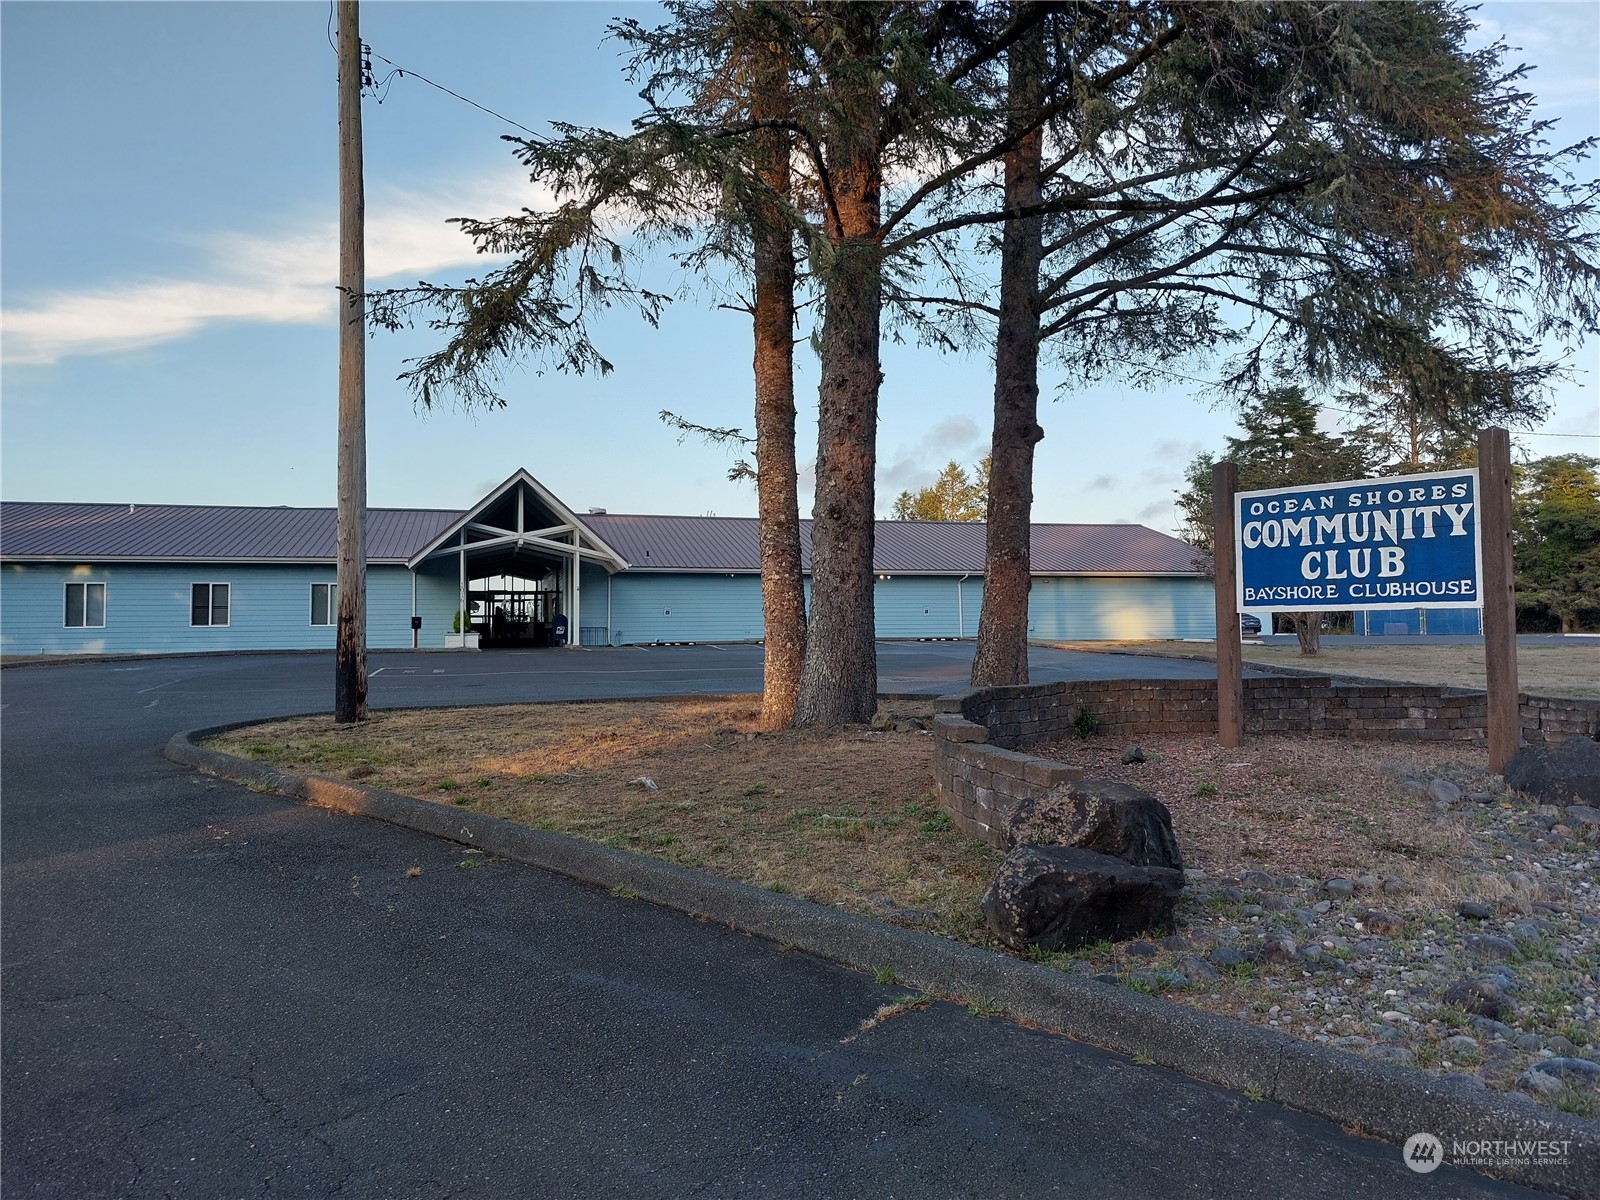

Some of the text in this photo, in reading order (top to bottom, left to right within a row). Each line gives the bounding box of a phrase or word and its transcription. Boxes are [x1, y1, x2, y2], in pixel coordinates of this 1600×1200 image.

[1250, 483, 1468, 516] OCEAN SHORES
[1242, 502, 1474, 549] COMMUNITY
[1300, 546, 1406, 580] CLUB
[1245, 579, 1476, 601] BAYSHORE CLUBHOUSE
